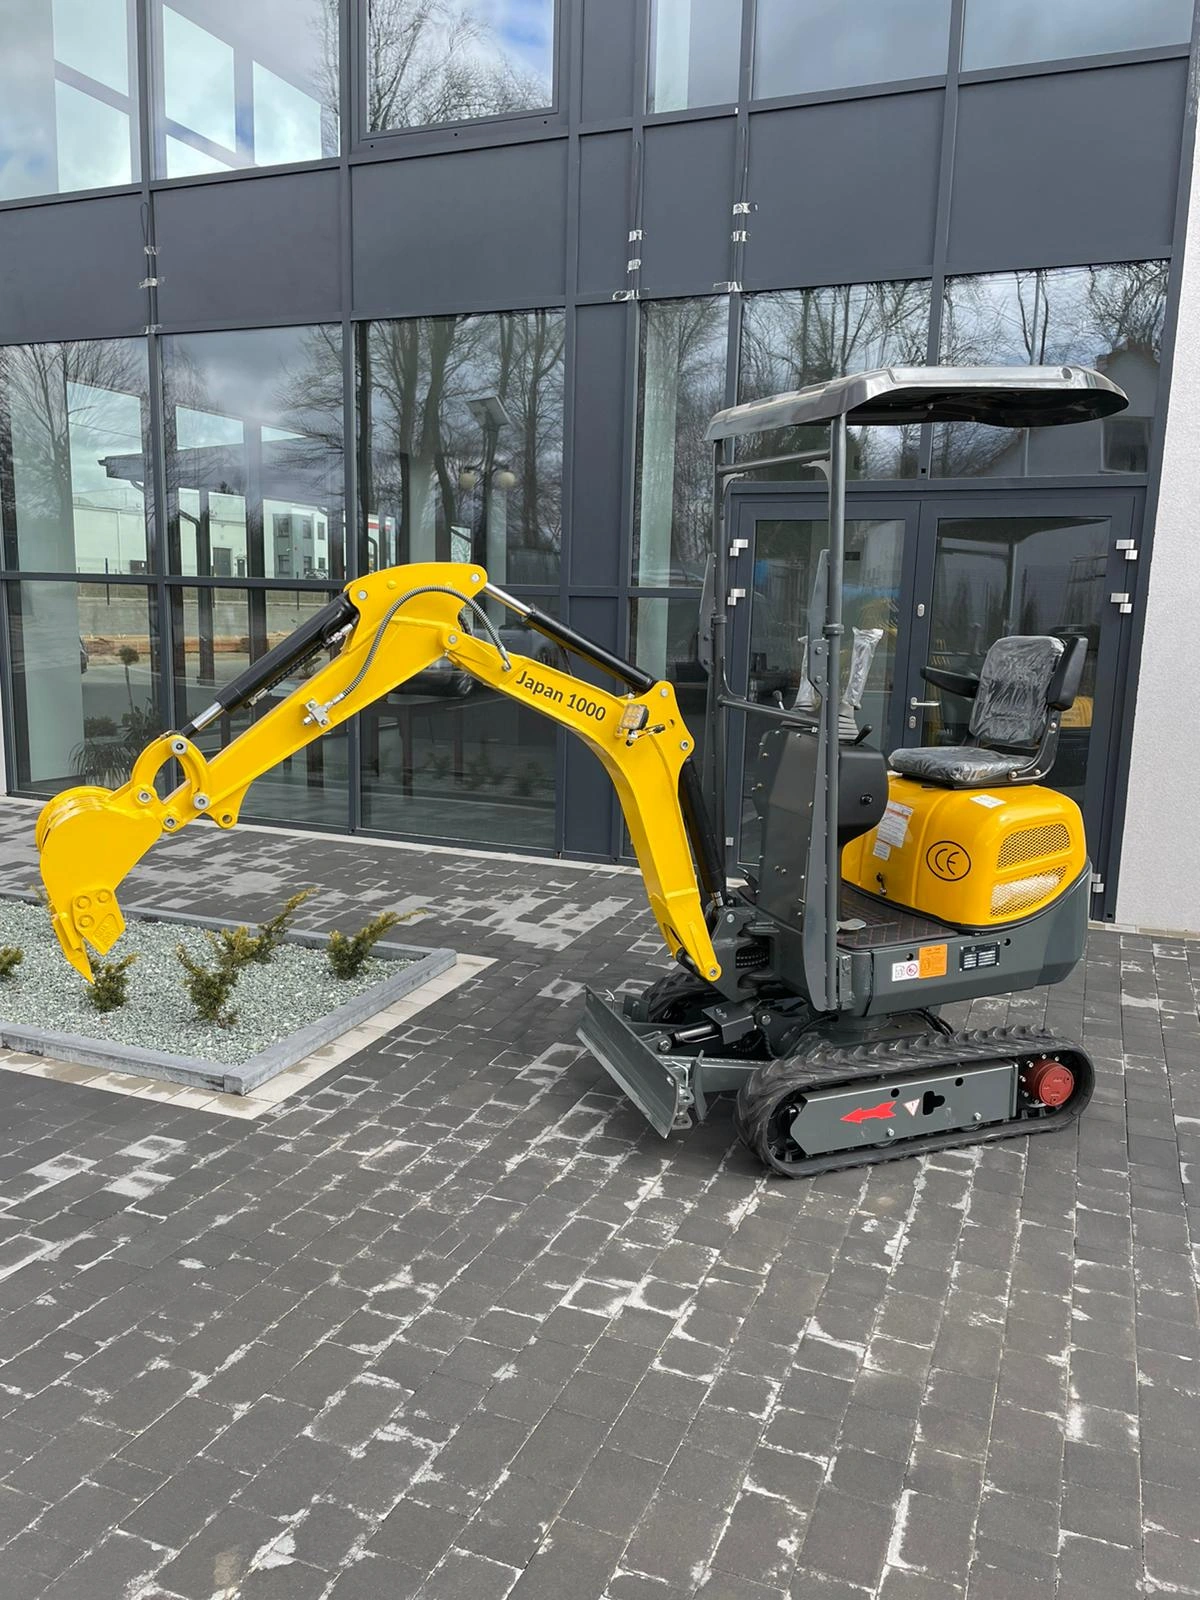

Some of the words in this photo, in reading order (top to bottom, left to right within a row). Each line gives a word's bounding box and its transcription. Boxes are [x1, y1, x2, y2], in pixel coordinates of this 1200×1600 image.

[516, 671, 564, 703] Japan
[567, 693, 606, 721] 1000
[935, 848, 960, 876] CE
